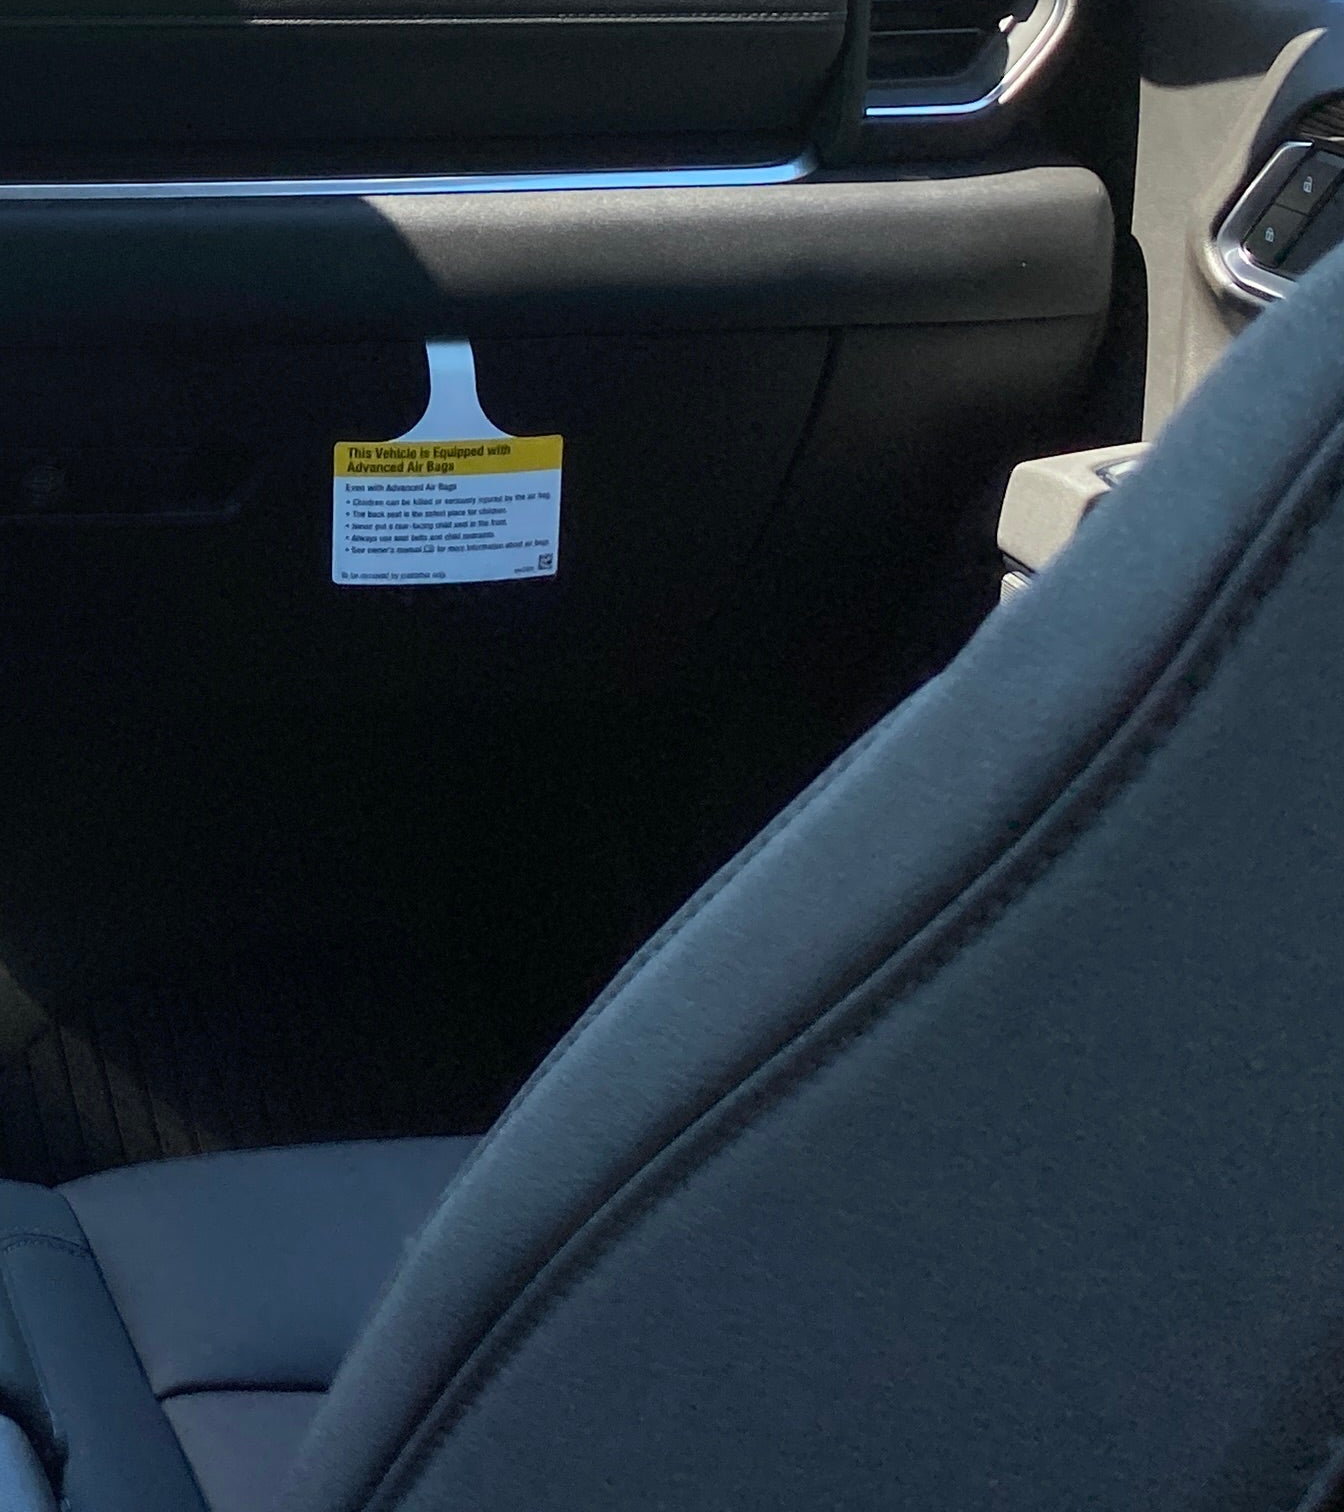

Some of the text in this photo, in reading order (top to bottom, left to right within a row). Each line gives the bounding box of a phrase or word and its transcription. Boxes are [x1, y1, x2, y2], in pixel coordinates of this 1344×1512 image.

[348, 443, 511, 460] This Vehicle is Equipped with
[347, 460, 455, 474] Advanced Air Bags
